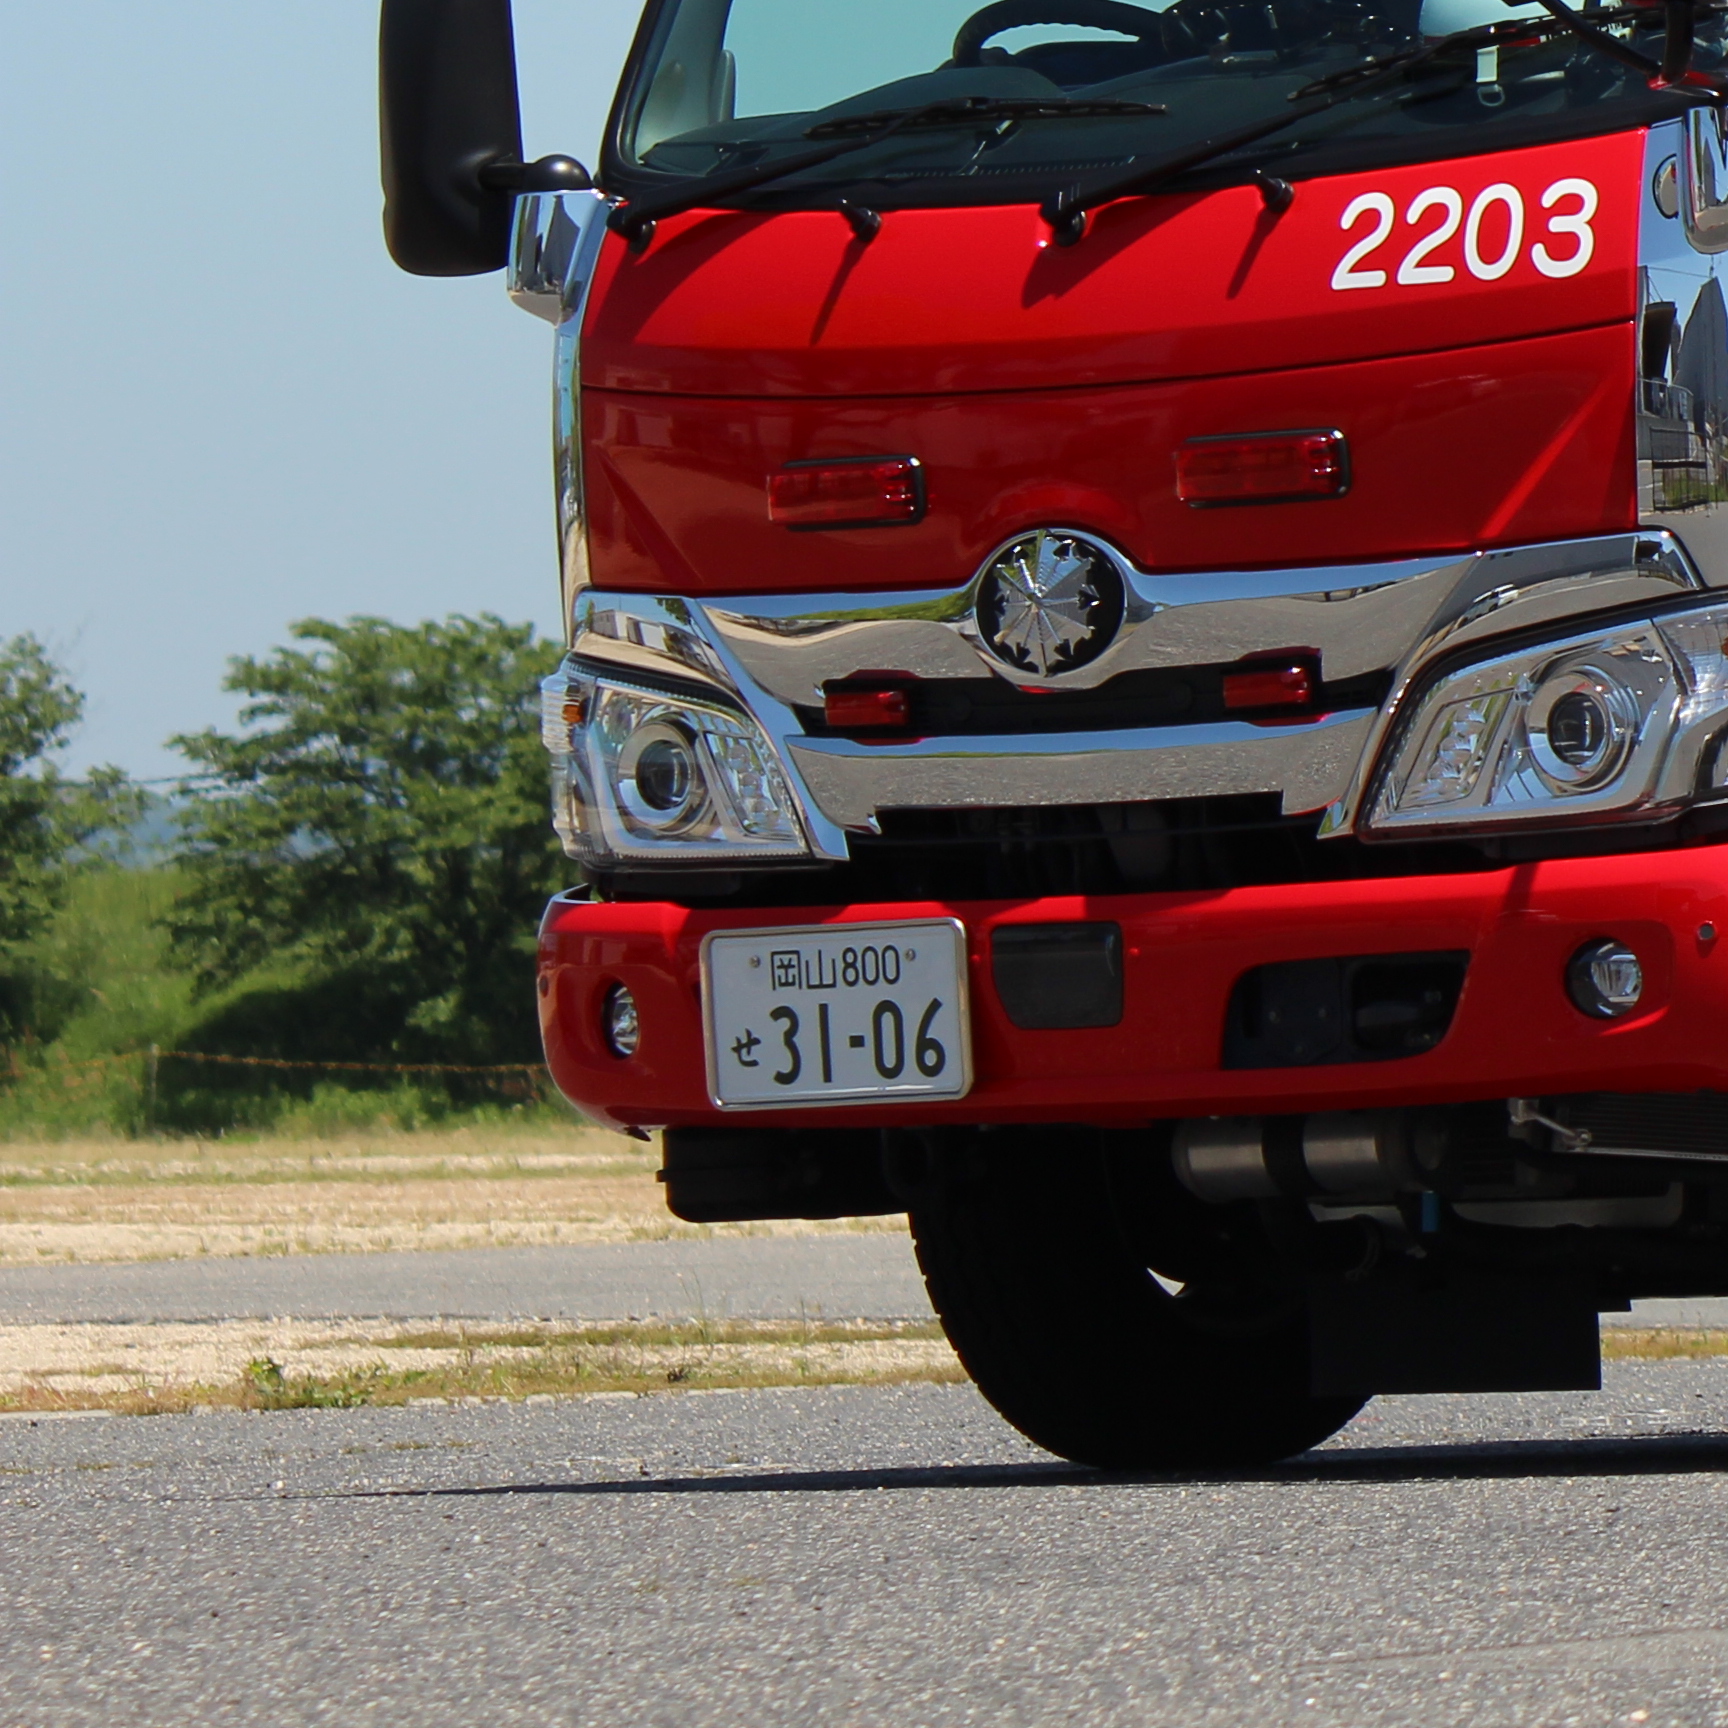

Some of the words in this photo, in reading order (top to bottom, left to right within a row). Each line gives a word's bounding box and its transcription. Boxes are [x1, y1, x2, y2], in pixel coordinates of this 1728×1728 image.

[1331, 177, 1598, 291] 2203
[730, 1028, 762, 1068] せ
[769, 996, 947, 1086] 31-06
